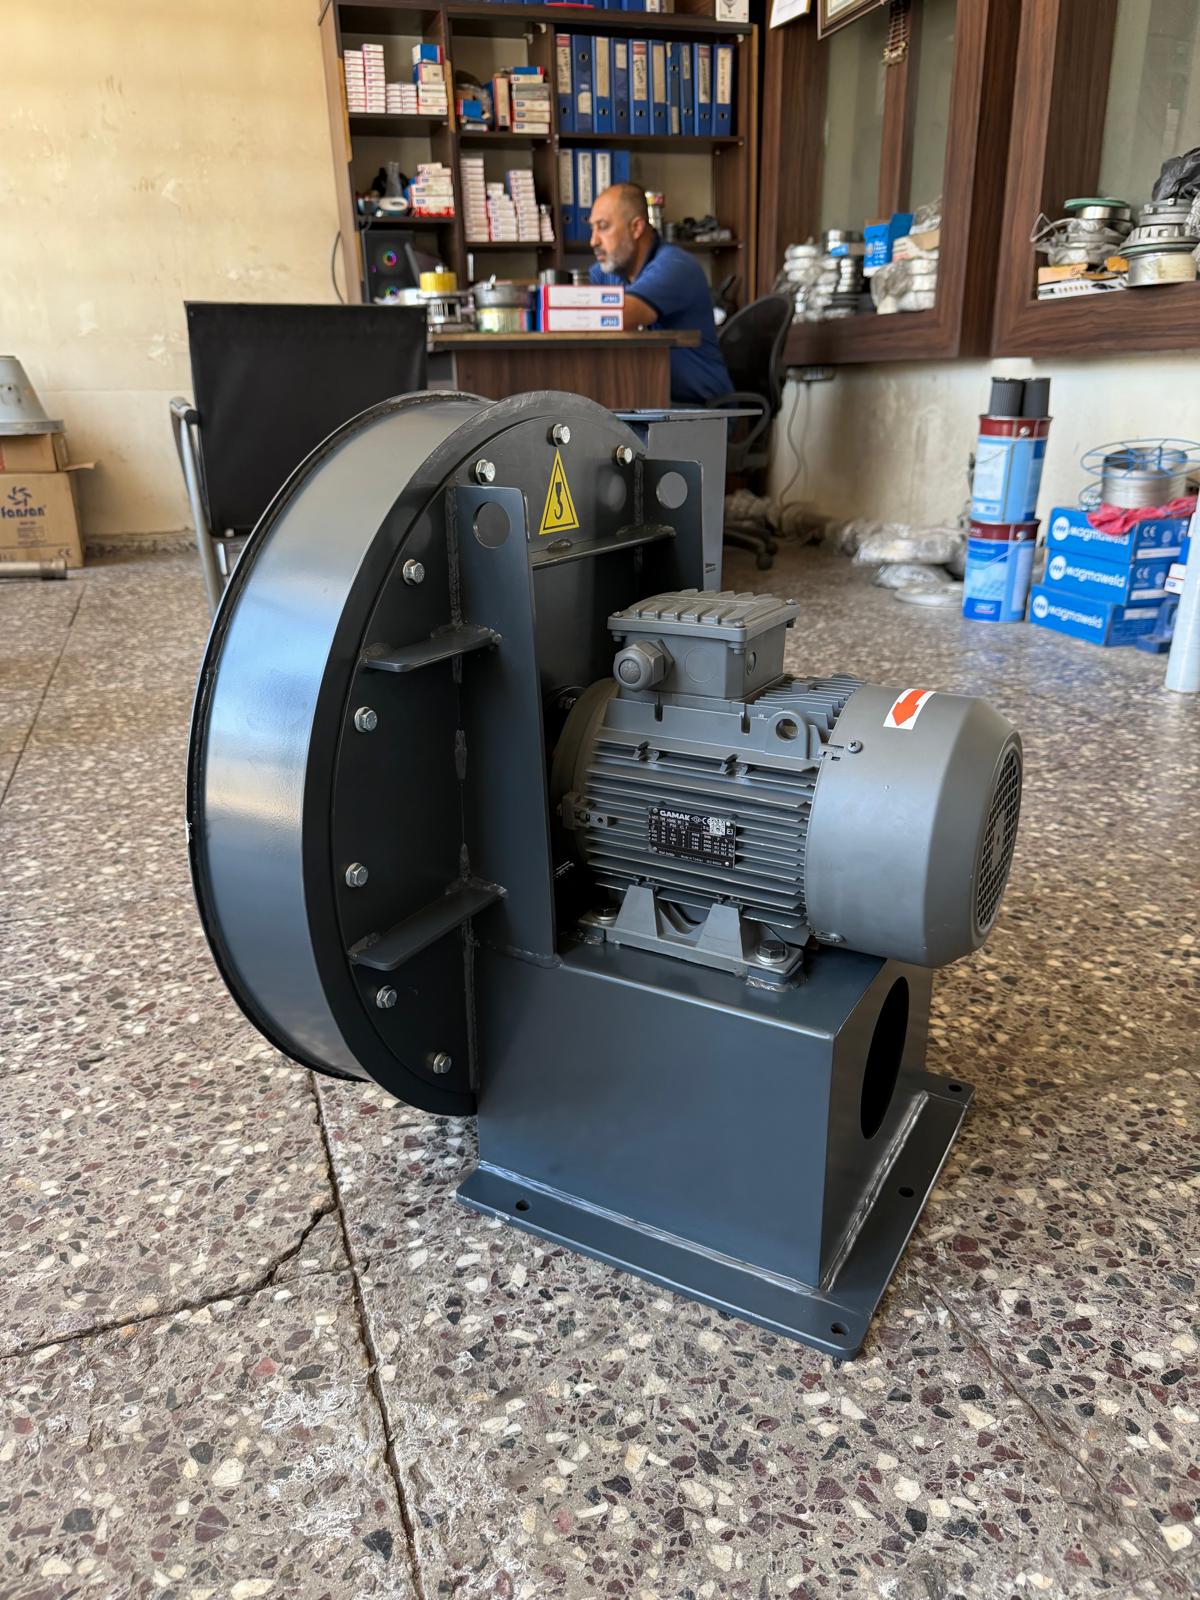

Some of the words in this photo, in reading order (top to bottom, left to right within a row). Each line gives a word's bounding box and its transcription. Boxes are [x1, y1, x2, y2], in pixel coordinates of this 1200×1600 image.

[1066, 565, 1125, 588] magmaweld
[1048, 605, 1103, 629] magmaweld
[660, 810, 690, 821] GAMAK
